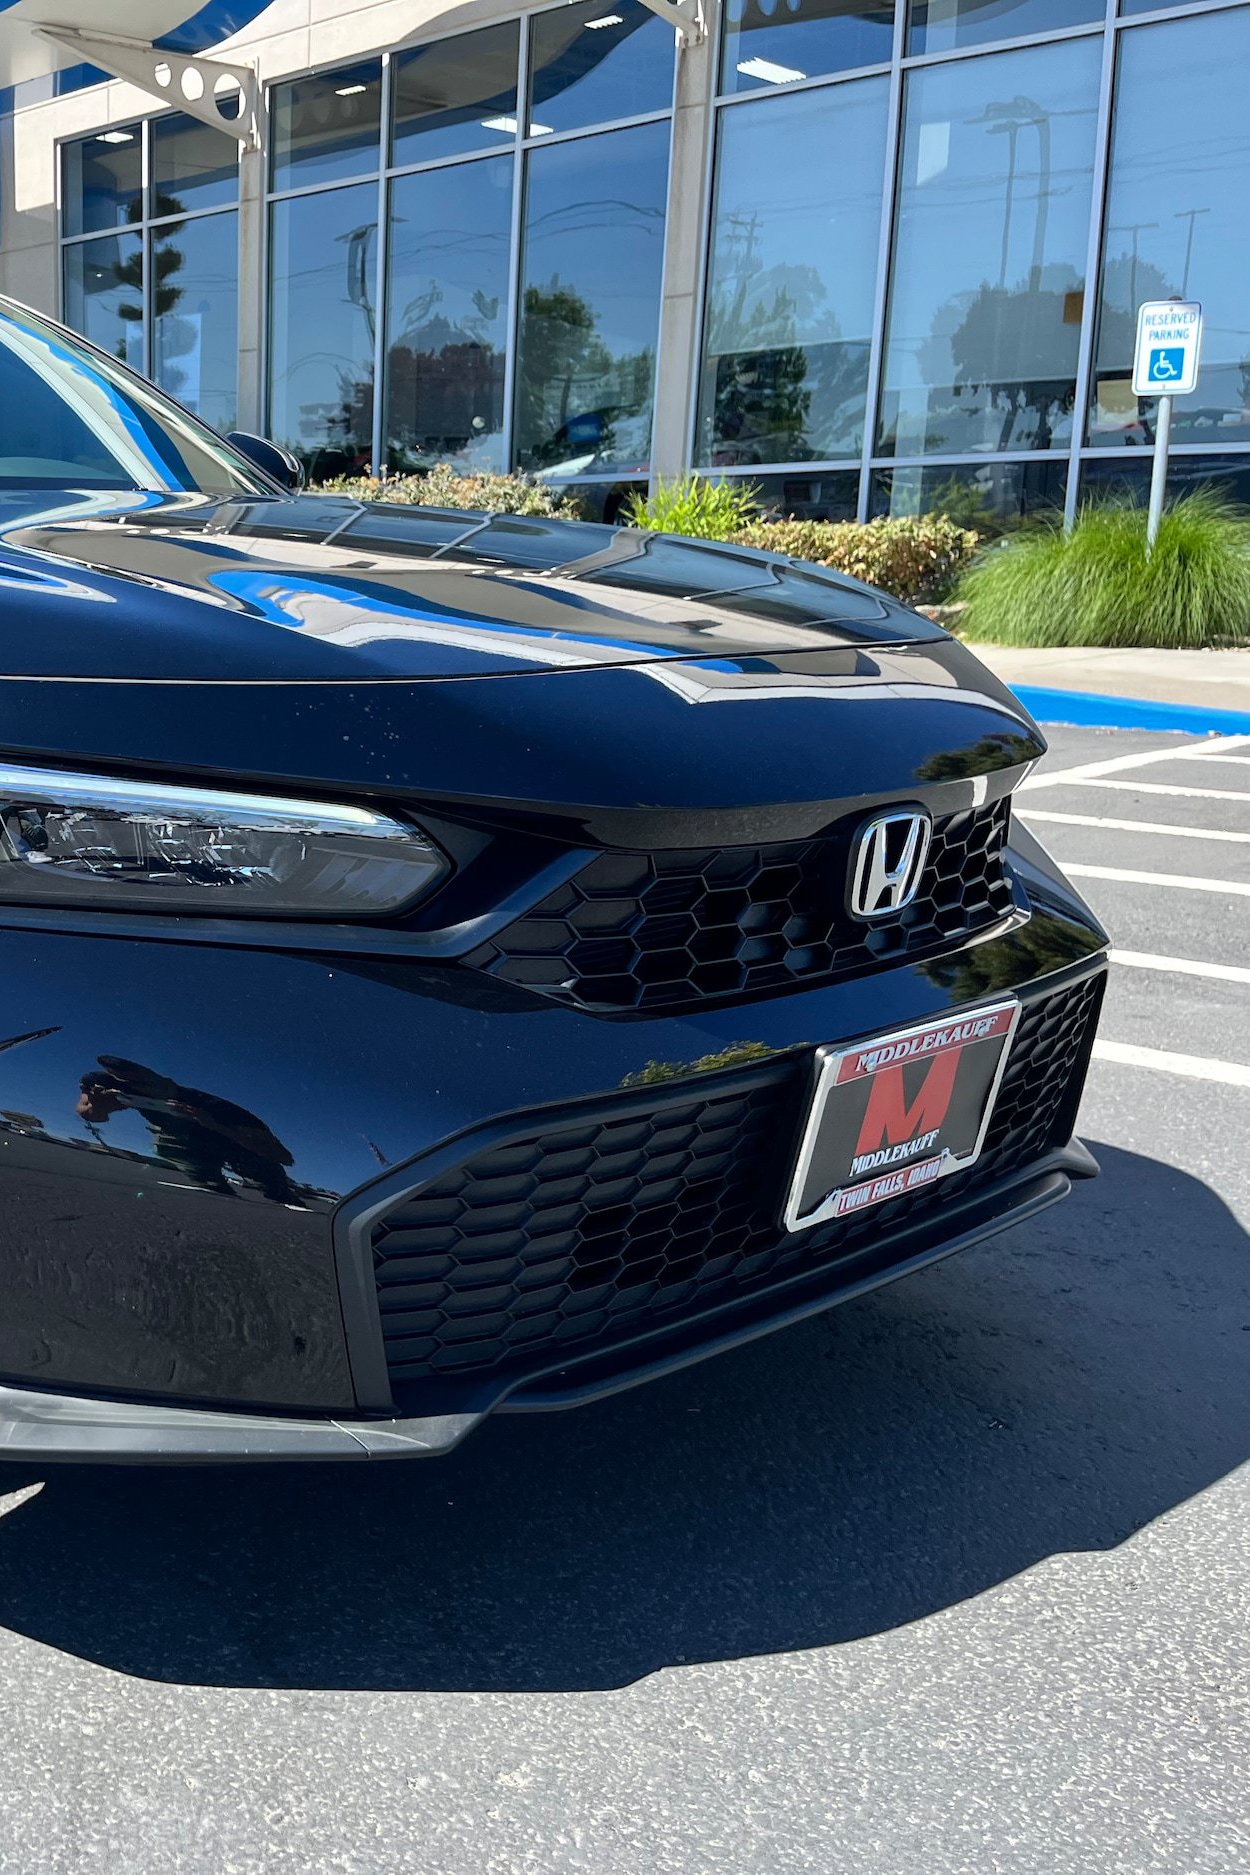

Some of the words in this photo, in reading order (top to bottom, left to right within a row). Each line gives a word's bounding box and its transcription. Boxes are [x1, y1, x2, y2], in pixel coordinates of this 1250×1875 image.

[1145, 311, 1197, 326] RESERVED
[1149, 328, 1190, 341] PARKING
[853, 1046, 963, 1158] M
[849, 1129, 940, 1178] MIDDLEKAUFF
[839, 1185, 872, 1211] TWIN
[871, 1172, 905, 1200] FALLS,
[906, 1159, 941, 1187] IDAHO
